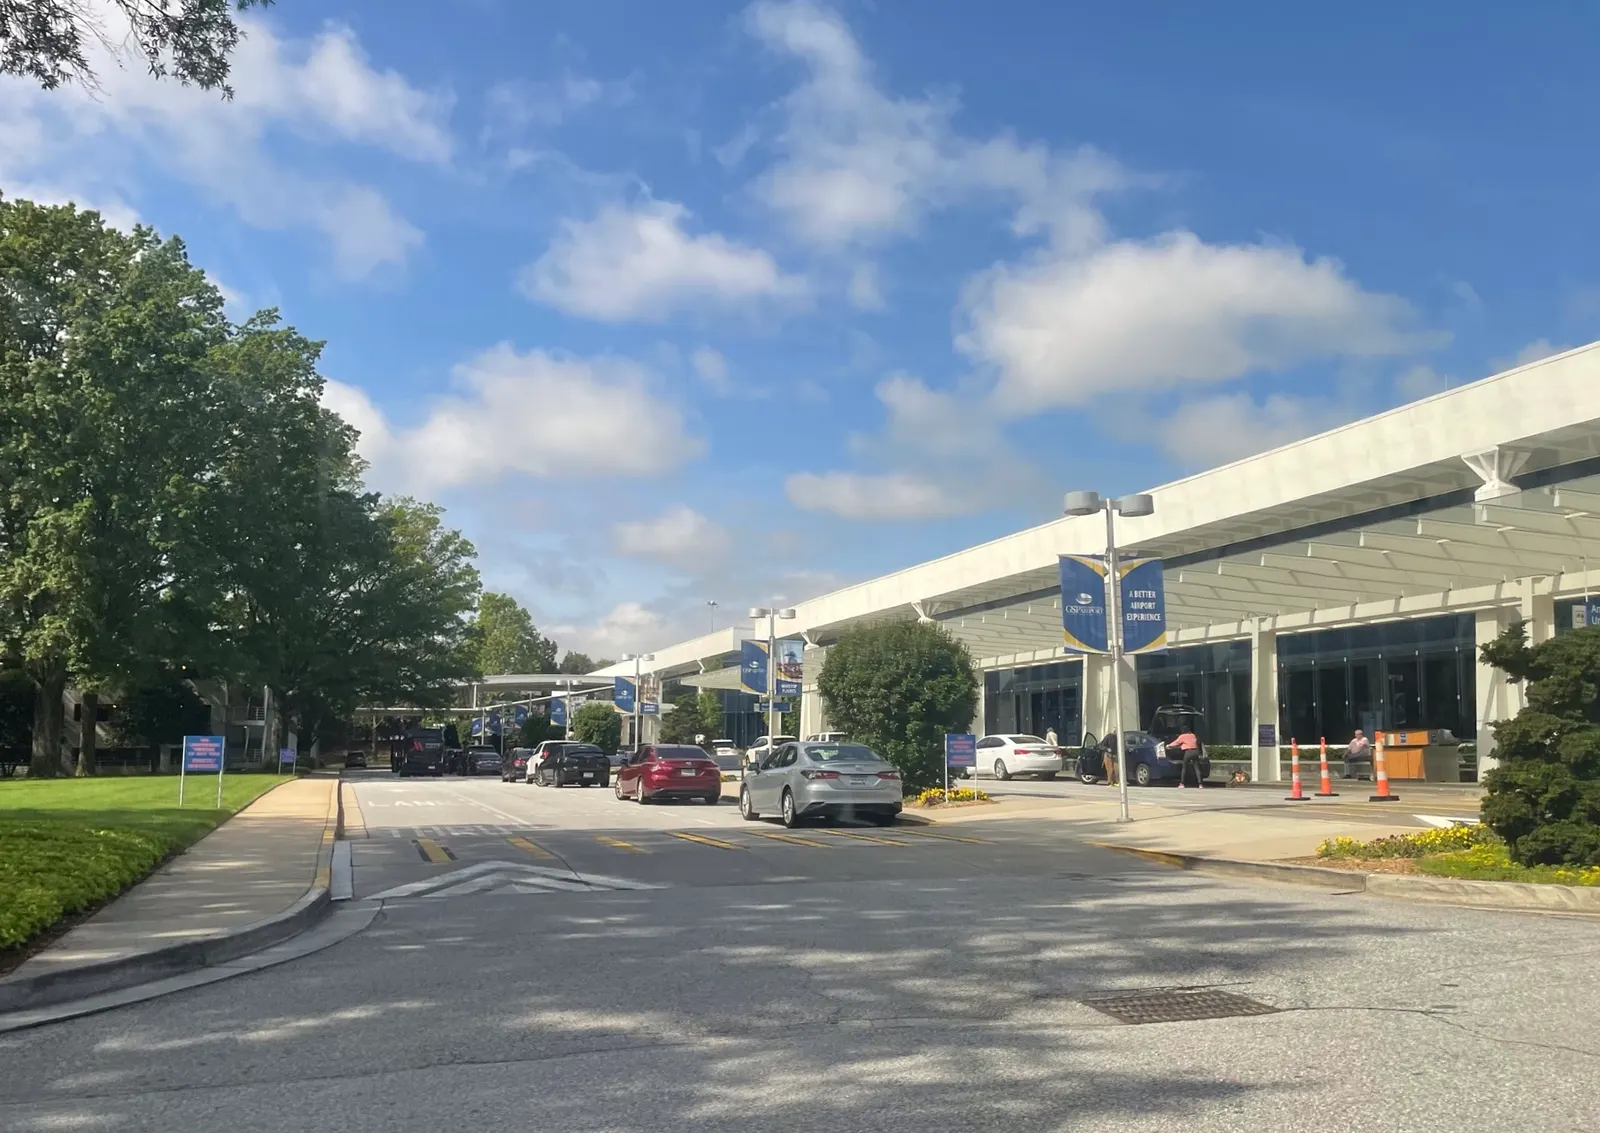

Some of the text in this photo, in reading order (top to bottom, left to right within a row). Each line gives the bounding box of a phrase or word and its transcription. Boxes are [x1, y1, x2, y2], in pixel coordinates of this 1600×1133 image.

[1134, 590, 1156, 598] BETTER
[1131, 602, 1156, 610] AIRPORT
[1127, 613, 1161, 621] EXPERIENCE
